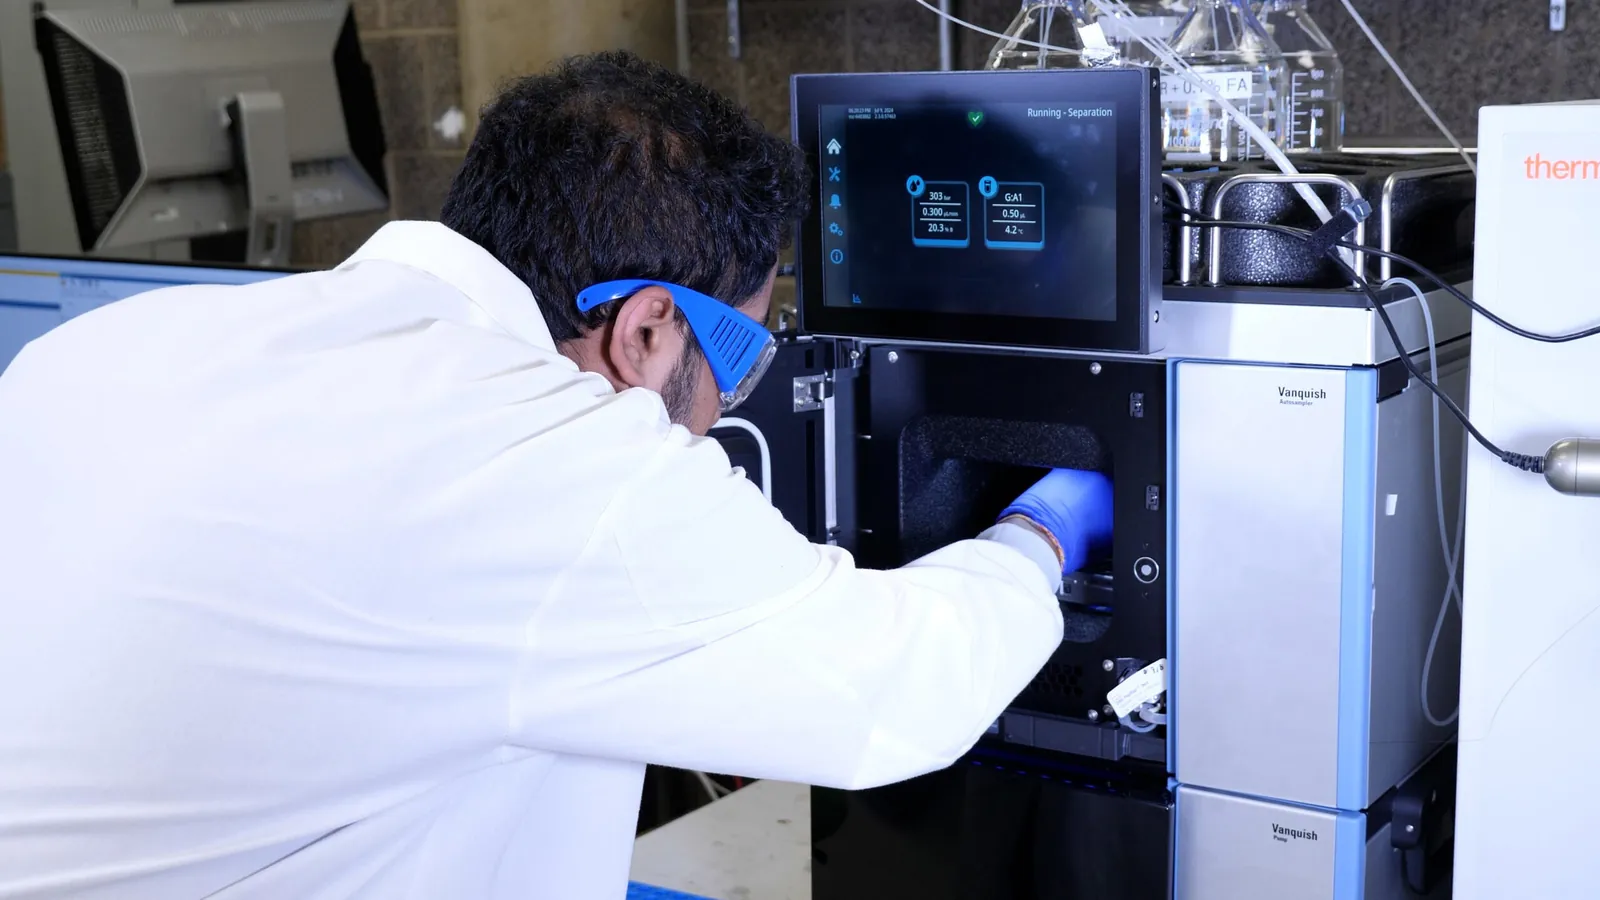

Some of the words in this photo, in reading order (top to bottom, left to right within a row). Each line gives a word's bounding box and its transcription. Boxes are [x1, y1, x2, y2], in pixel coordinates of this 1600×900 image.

[1226, 77, 1248, 93] FA
[1027, 107, 1062, 119] Running
[1067, 107, 1113, 119] Separation
[1524, 152, 1600, 179] therm
[929, 191, 943, 201] 303
[1004, 193, 1022, 202] G:A1
[922, 207, 943, 217] 0.300
[1002, 209, 1020, 218] 0.50
[928, 223, 944, 232] 20.3
[1005, 225, 1017, 234] 4.2
[1278, 386, 1327, 400] Vanquish
[1272, 823, 1318, 841] Vanquish
[1273, 834, 1288, 843] Pump
